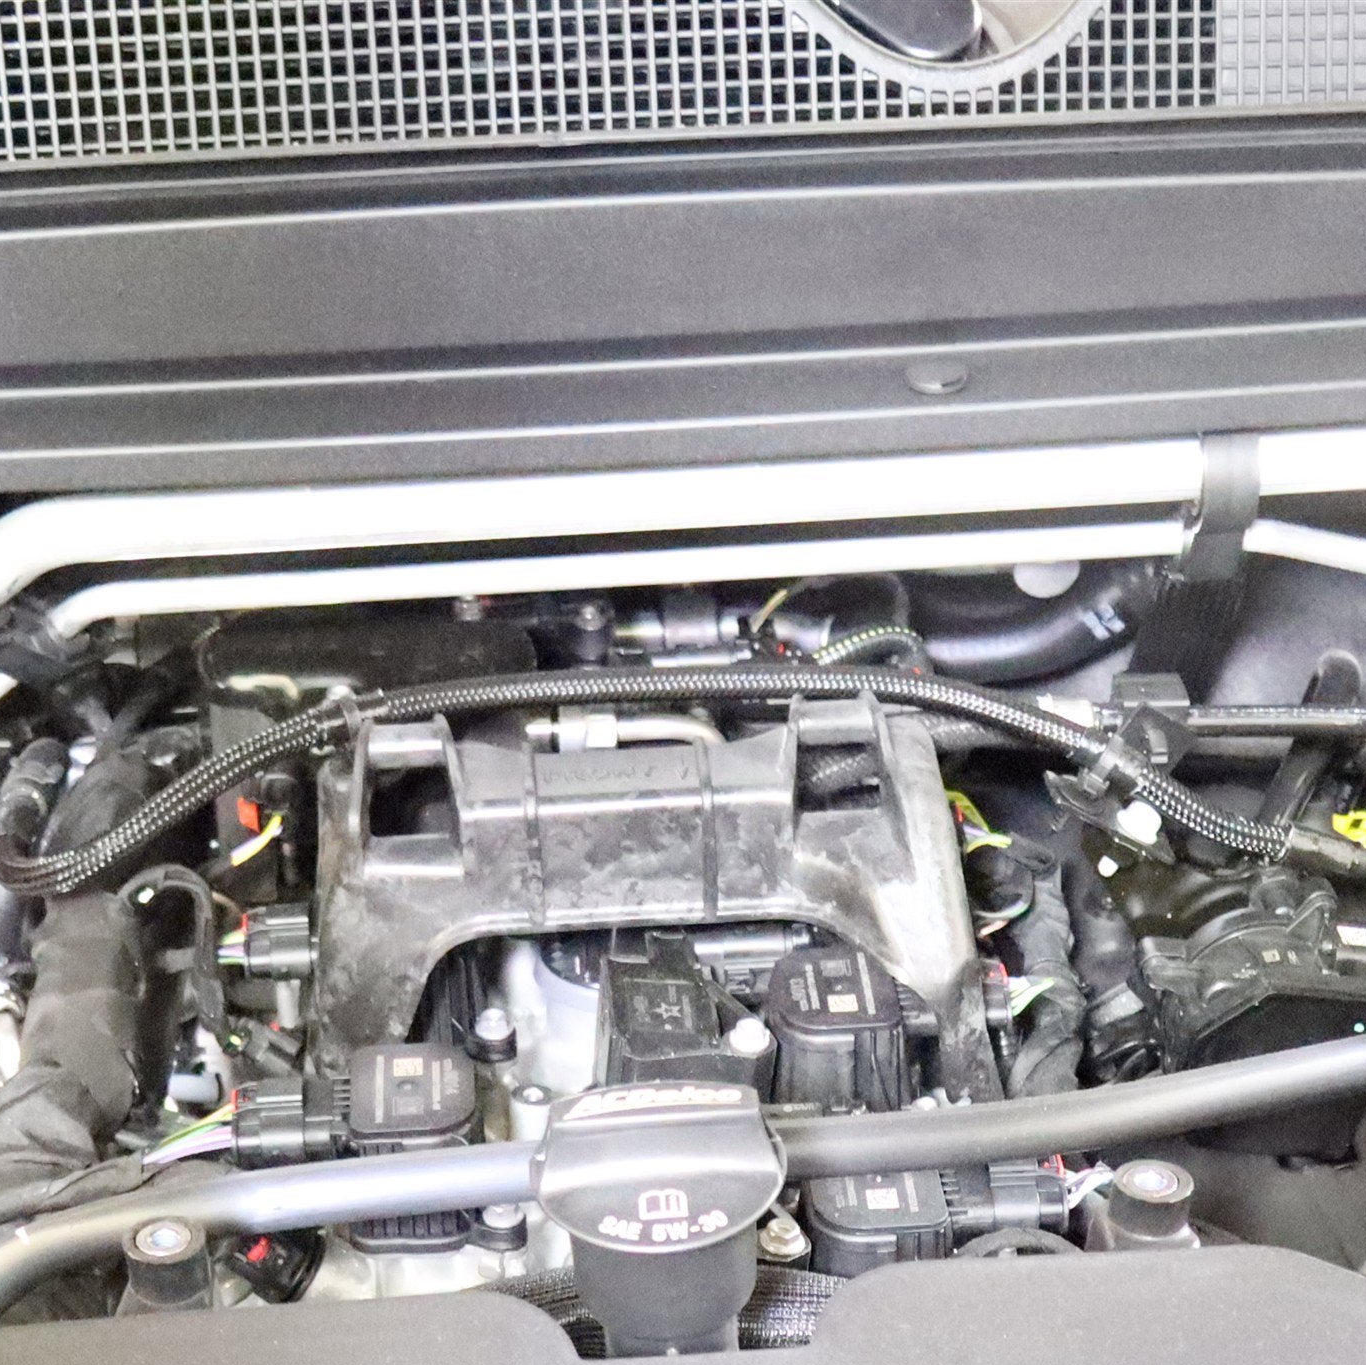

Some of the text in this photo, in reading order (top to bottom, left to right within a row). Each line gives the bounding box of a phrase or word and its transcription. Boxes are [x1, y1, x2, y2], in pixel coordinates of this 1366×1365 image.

[562, 1086, 743, 1120] ACDelco
[598, 1209, 729, 1242] SAE 5W-30
